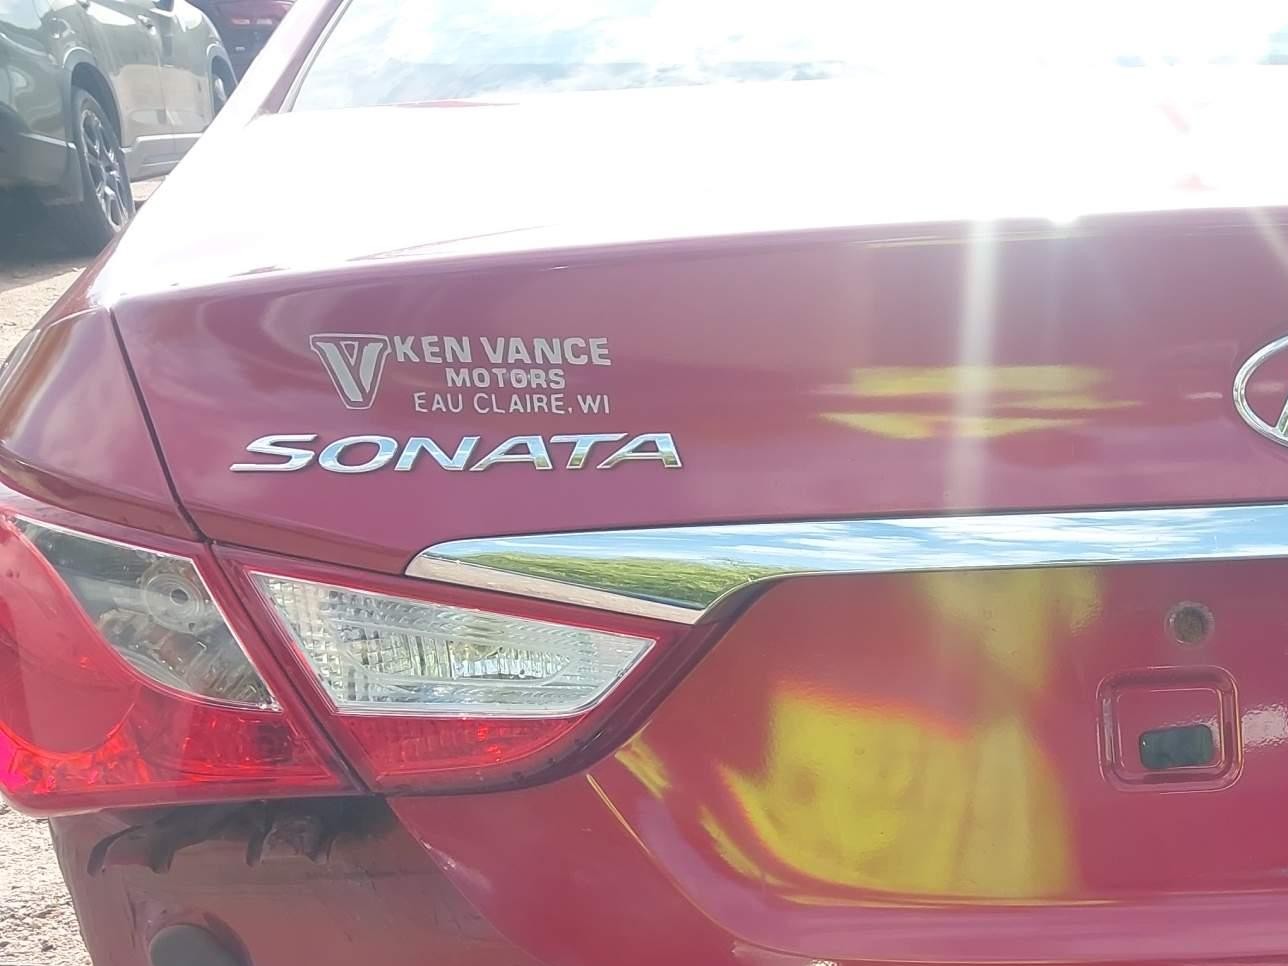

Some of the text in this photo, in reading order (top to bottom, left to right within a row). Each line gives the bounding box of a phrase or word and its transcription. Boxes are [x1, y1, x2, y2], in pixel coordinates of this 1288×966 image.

[394, 335, 612, 366] KEN VANCE
[446, 367, 566, 389] MOTORS
[414, 392, 610, 415] EAU CLAIRE, WI
[230, 432, 683, 473] SONATA
